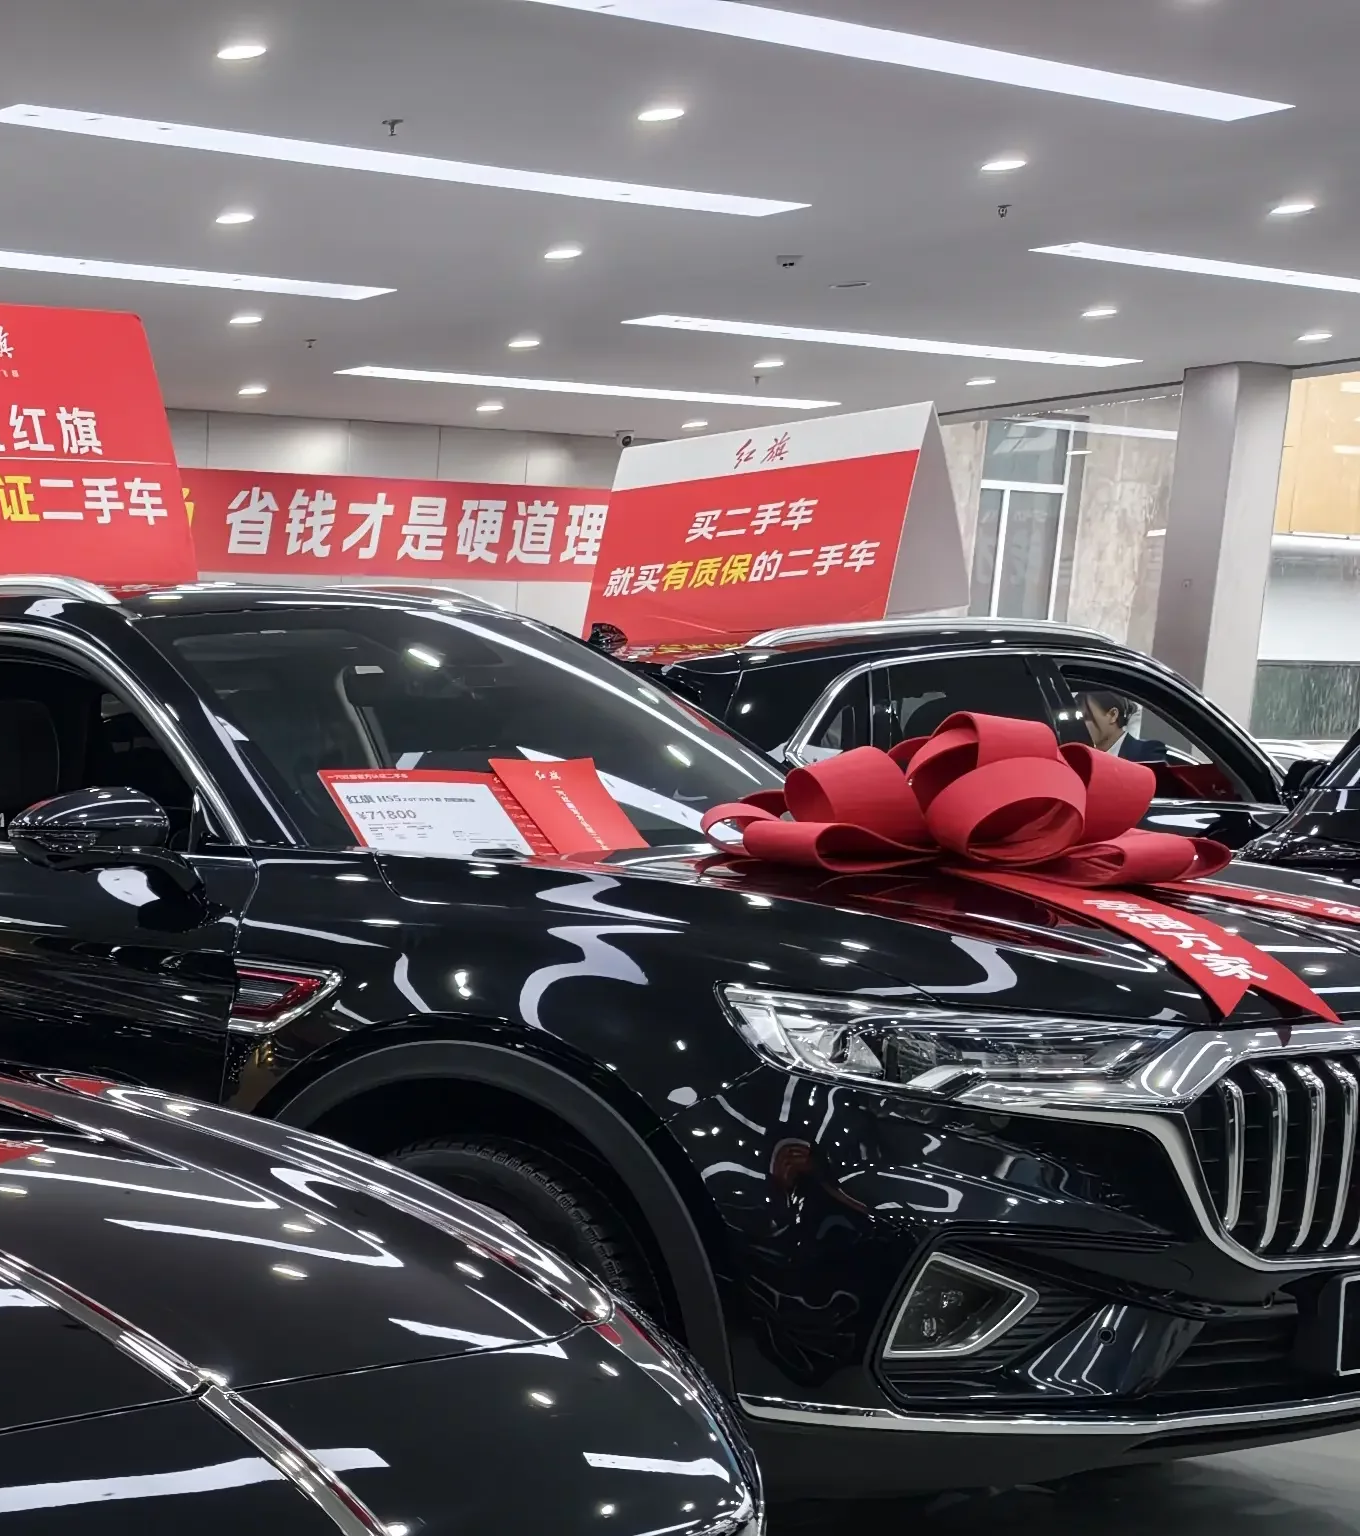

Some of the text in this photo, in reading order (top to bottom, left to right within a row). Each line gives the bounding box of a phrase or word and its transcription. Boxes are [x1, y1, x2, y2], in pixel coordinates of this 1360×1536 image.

[734, 431, 791, 469] 红旗
[225, 486, 607, 567] 省钱才是硬道理
[685, 498, 820, 543] 买二手车
[602, 540, 881, 598] 就买有质保的二手车
